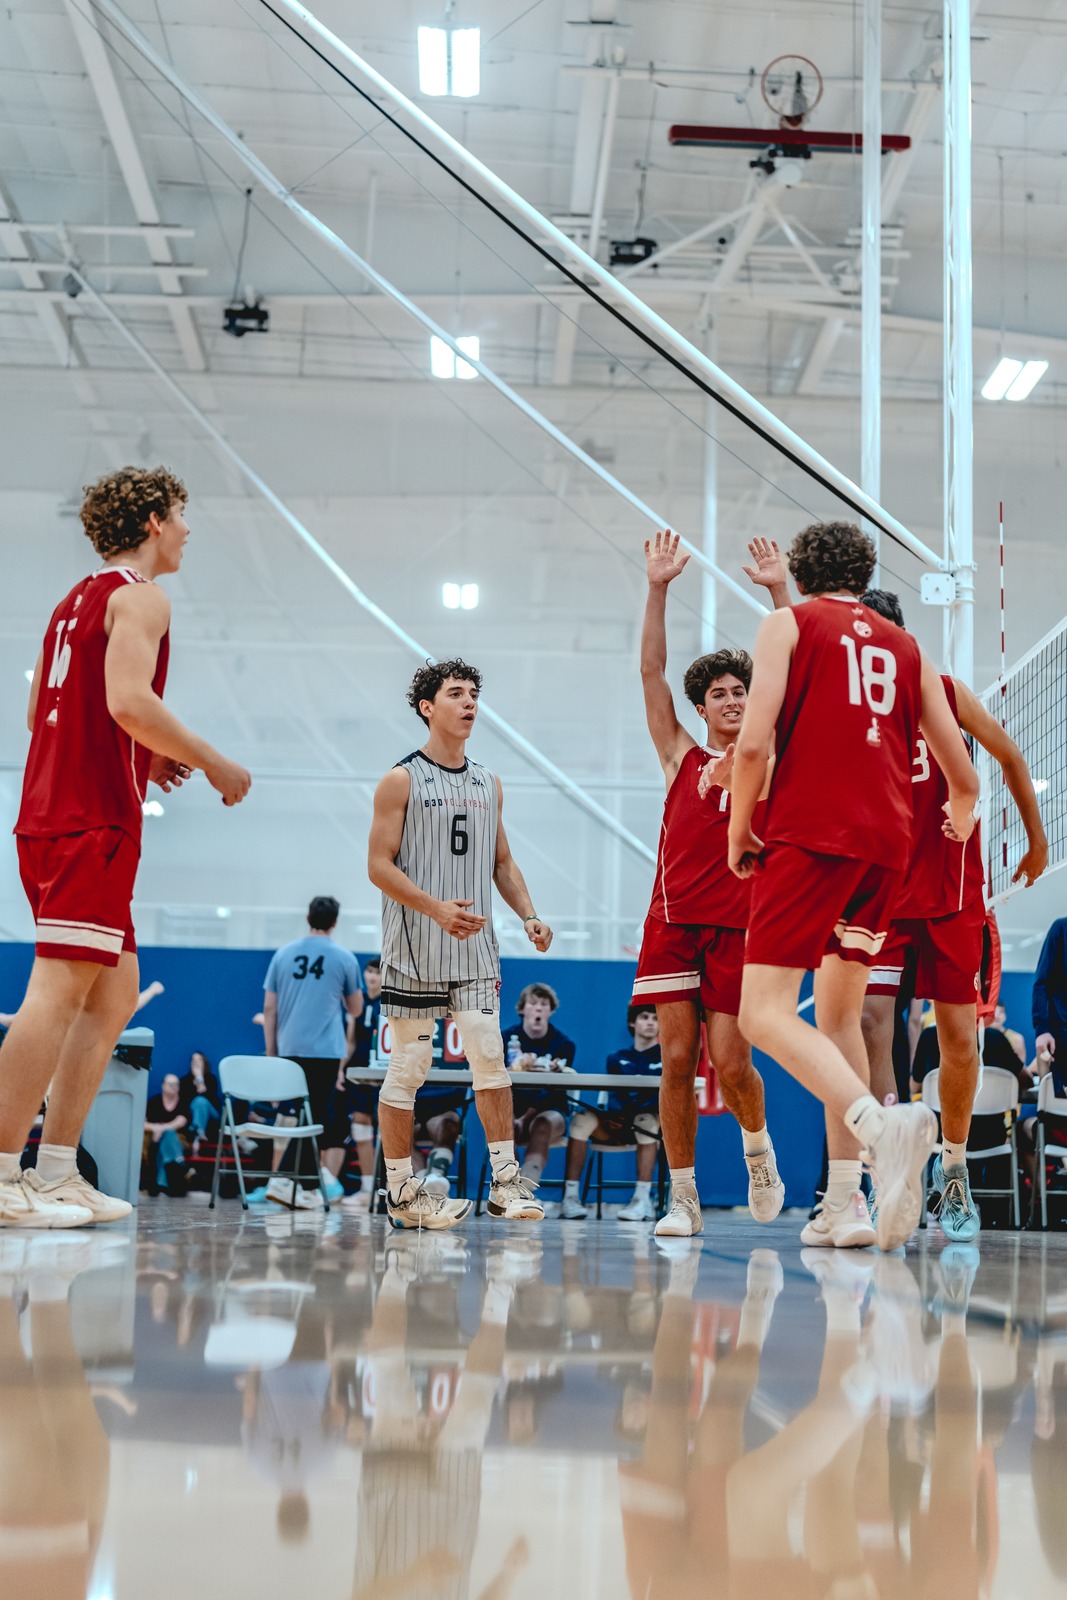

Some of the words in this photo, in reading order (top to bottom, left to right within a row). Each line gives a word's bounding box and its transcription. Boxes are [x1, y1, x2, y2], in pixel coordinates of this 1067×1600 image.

[840, 634, 897, 716] 18
[450, 814, 469, 856] 6
[293, 954, 325, 980] 34
